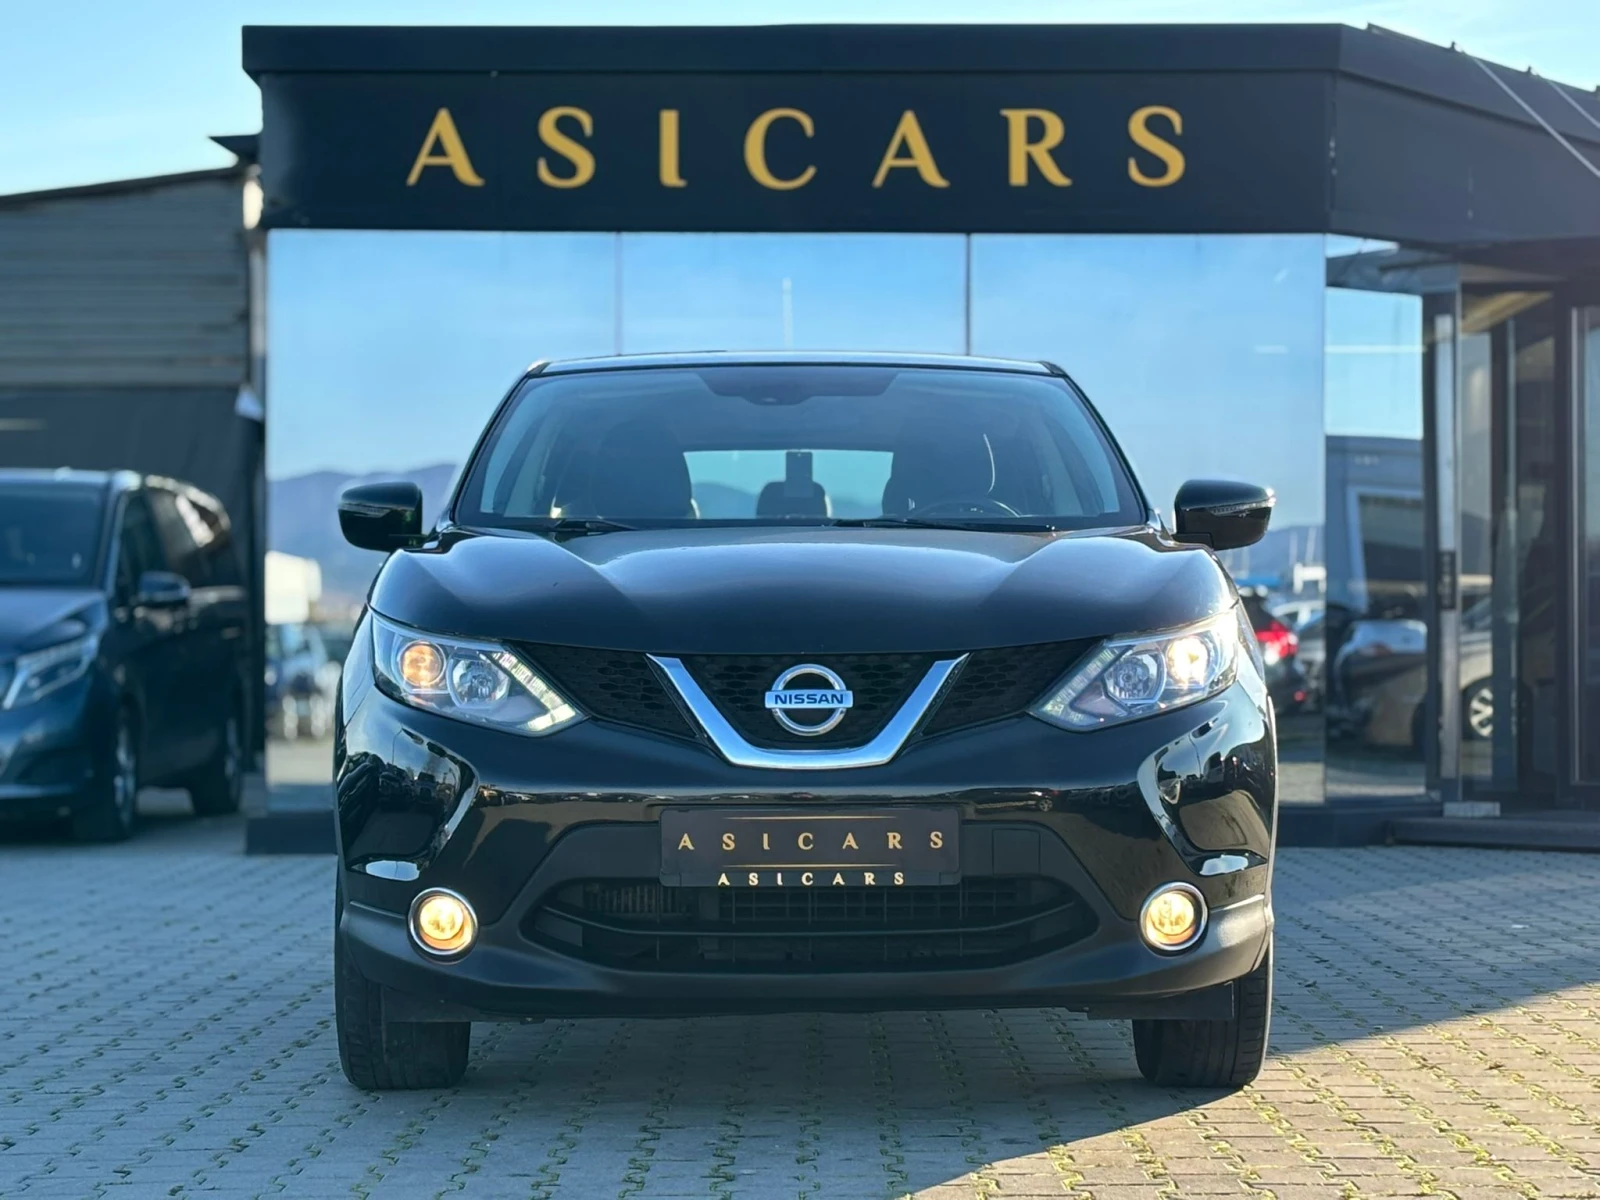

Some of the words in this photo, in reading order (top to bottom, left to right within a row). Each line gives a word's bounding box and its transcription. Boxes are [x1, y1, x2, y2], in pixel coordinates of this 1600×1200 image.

[407, 106, 1186, 190] ASICARS
[774, 693, 844, 705] NISSAN
[678, 831, 944, 851] ASICARS
[717, 872, 905, 886] ASICARS
